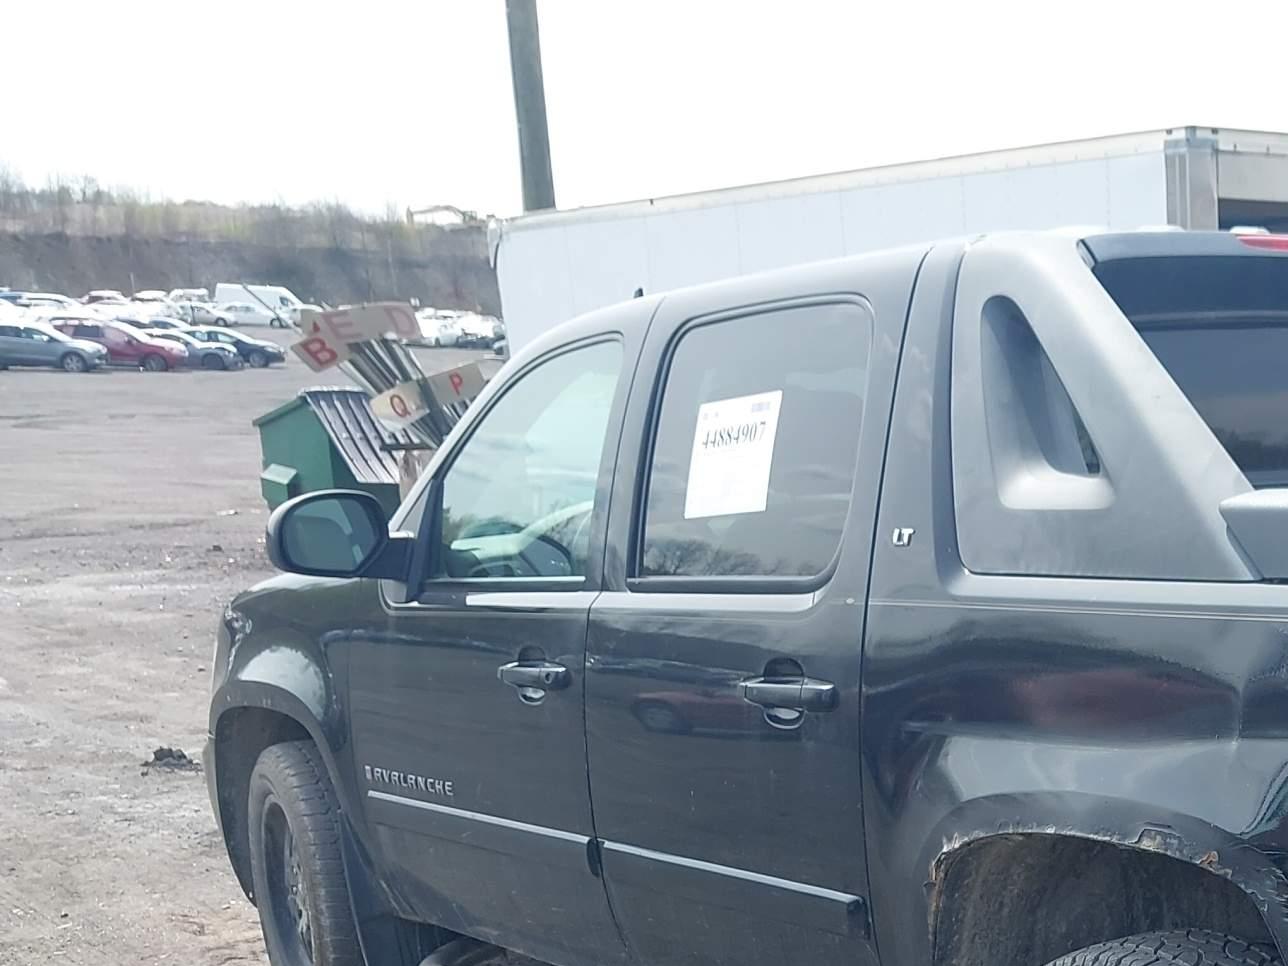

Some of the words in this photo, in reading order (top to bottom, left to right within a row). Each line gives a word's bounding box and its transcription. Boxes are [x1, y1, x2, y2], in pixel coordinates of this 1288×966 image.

[321, 310, 362, 339] E
[384, 304, 417, 335] D
[301, 337, 338, 367] B
[449, 372, 464, 396] P
[390, 394, 412, 419] Q
[701, 420, 767, 449] 44884907
[892, 527, 914, 547] LT
[372, 766, 455, 796] AVALANCHE
